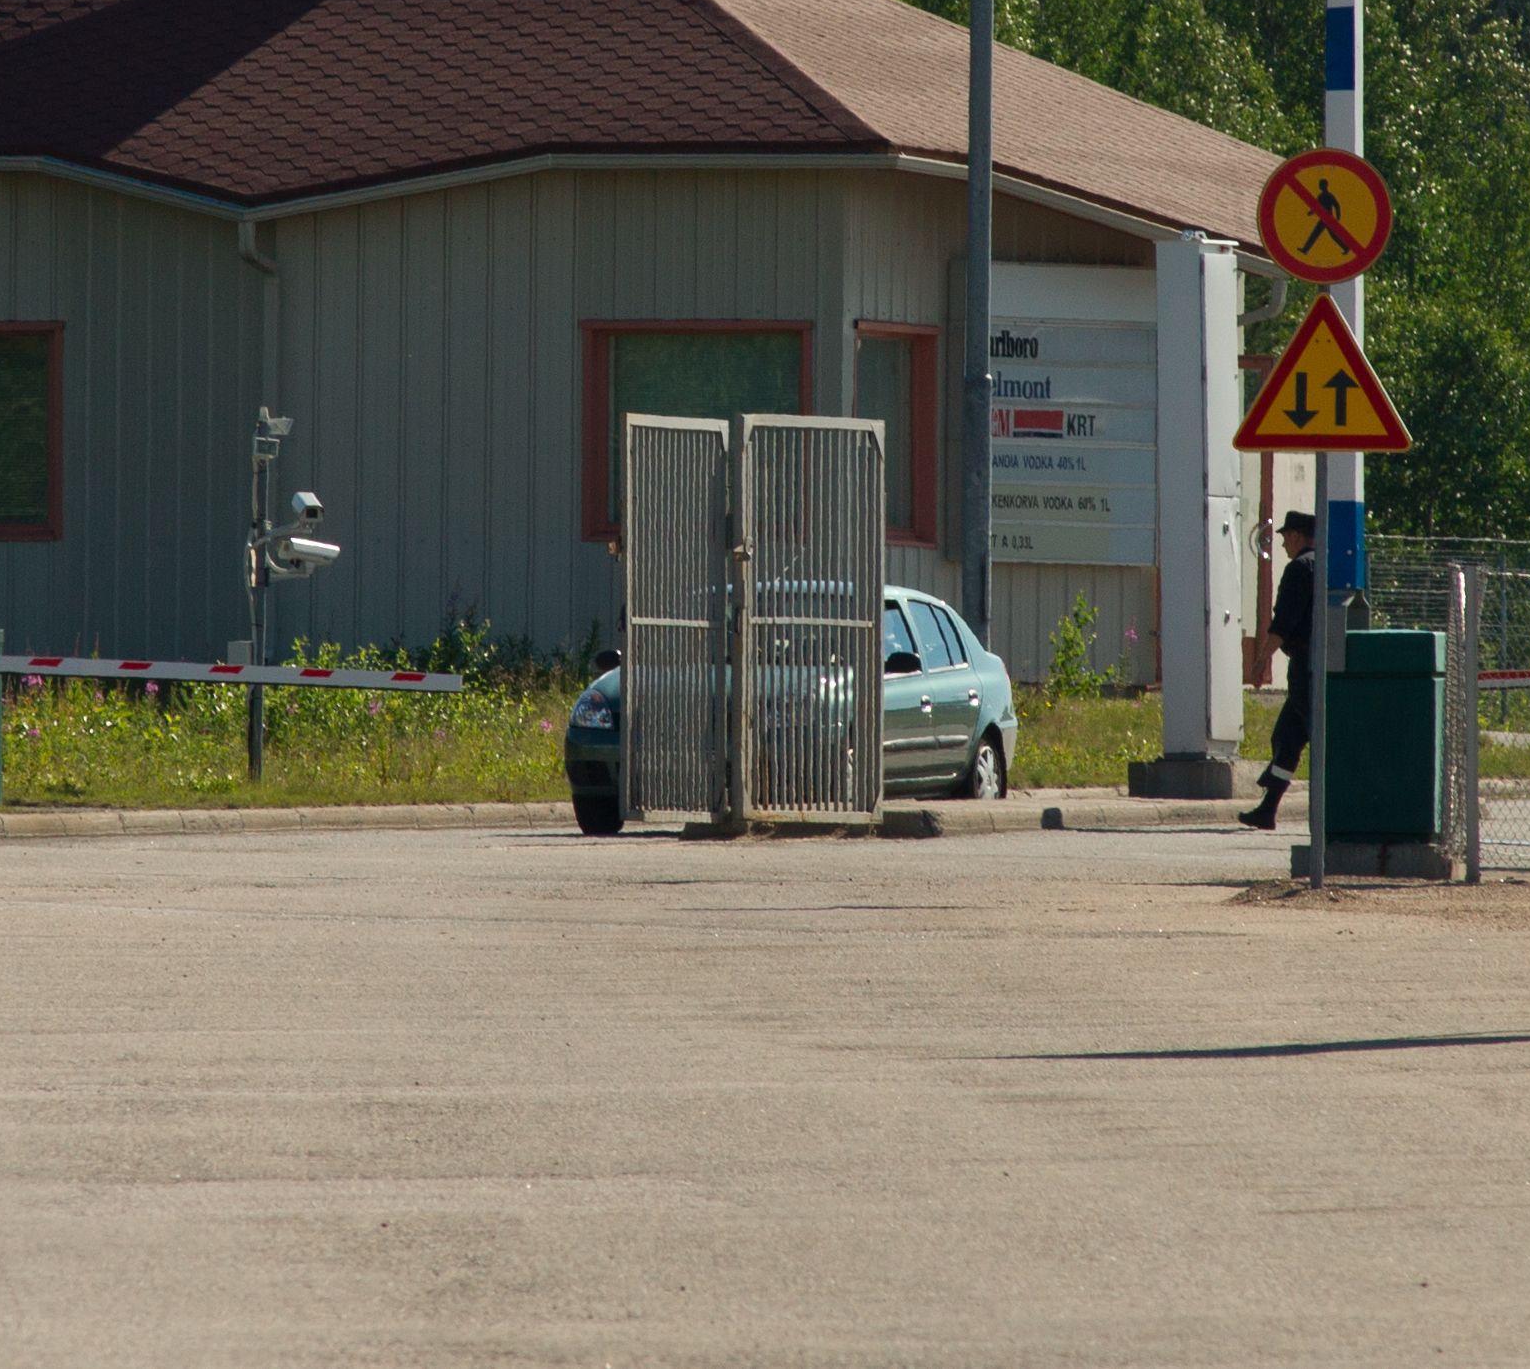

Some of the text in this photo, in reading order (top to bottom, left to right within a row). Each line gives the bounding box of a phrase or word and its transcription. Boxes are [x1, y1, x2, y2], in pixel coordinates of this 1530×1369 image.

[990, 330, 1039, 359] rlboro
[991, 371, 1051, 399] lmont
[1067, 413, 1096, 436] KRT
[991, 454, 1019, 469] ANDIA
[1023, 455, 1054, 470] VODKA
[1077, 456, 1086, 471] 1L
[991, 494, 1040, 509] KENKORVA
[1043, 496, 1074, 510] VODKA
[1100, 498, 1111, 512] 1L
